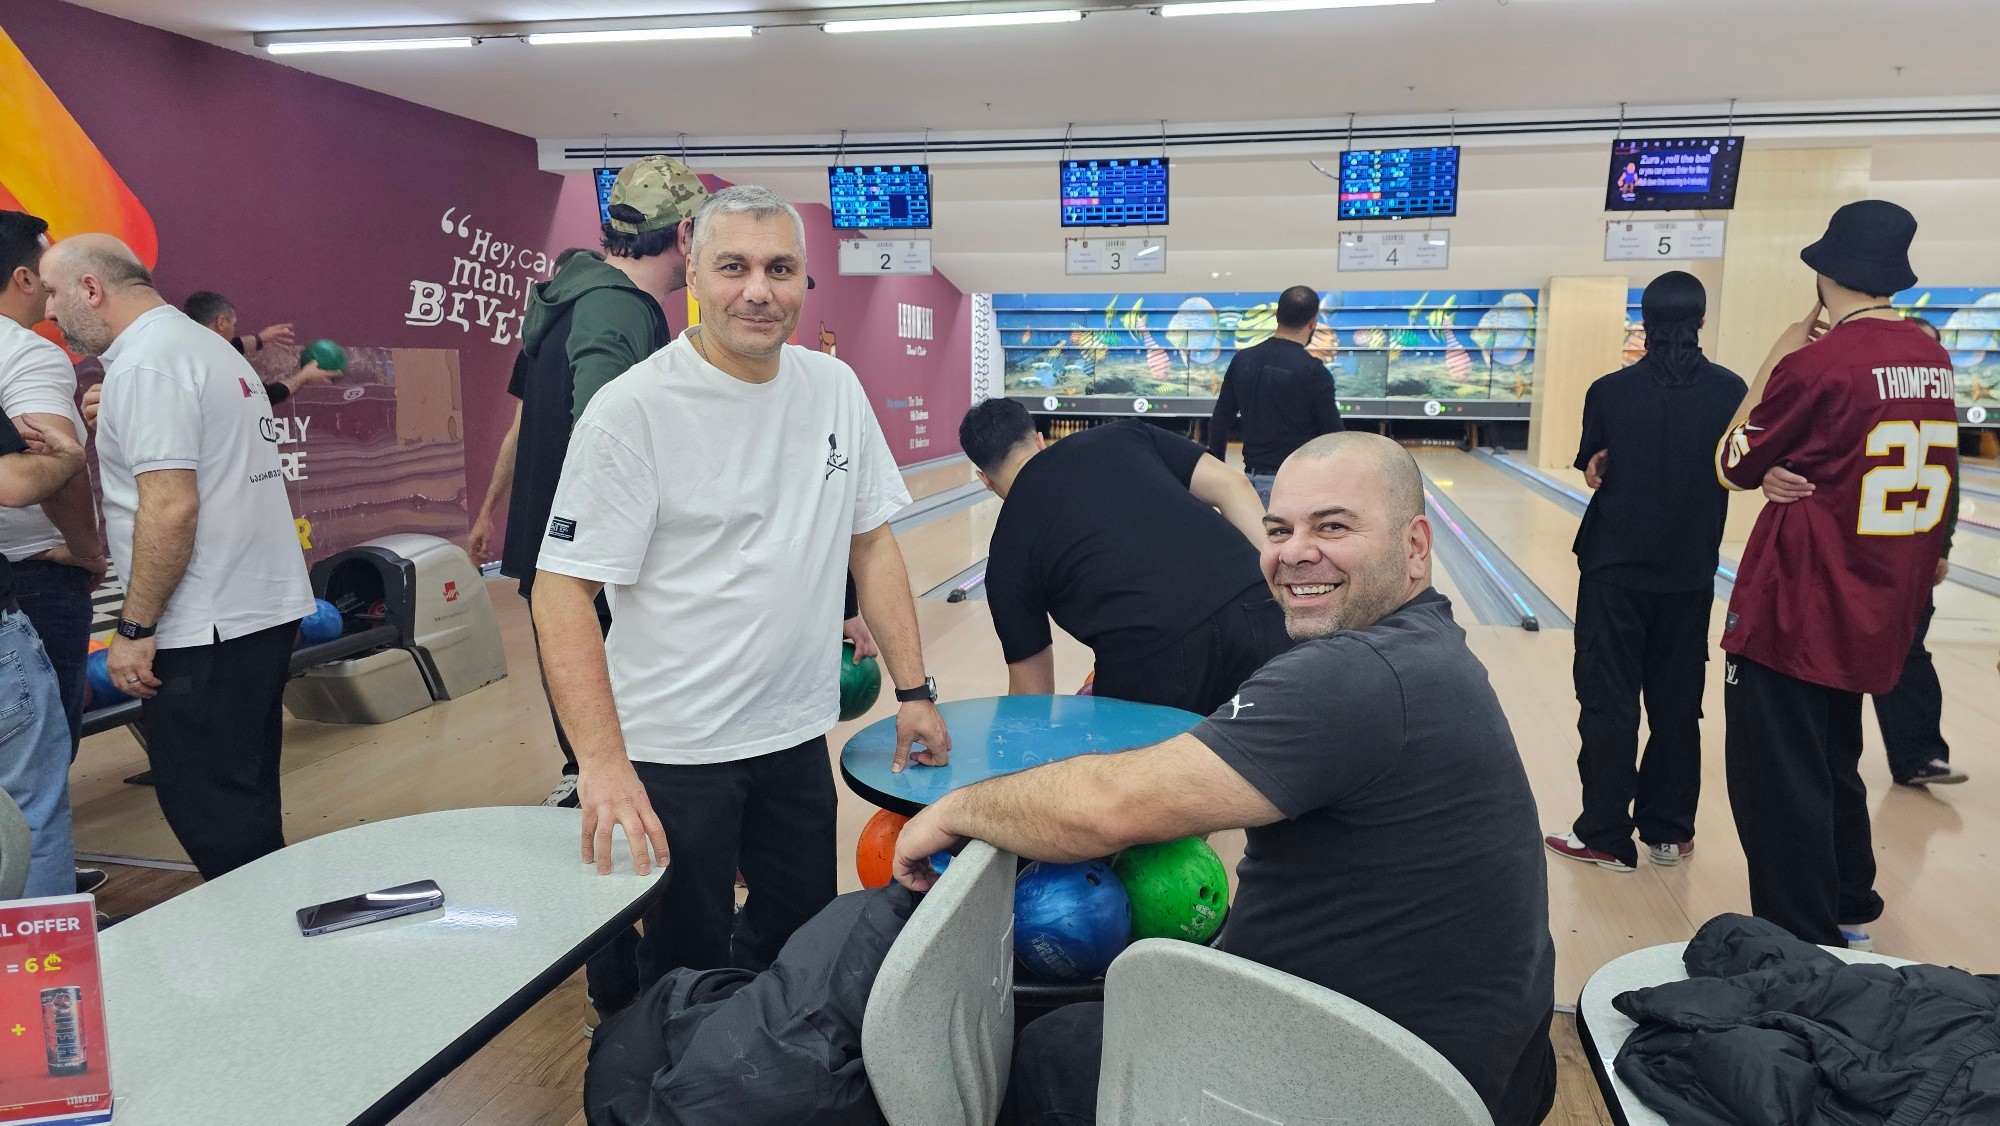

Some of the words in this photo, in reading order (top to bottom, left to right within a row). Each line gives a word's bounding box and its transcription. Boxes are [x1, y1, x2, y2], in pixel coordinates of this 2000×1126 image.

[1657, 236, 1671, 255] 5
[880, 253, 891, 270] 2
[1111, 252, 1121, 270] 3
[1386, 247, 1399, 266] 4
[448, 256, 521, 300] man,
[1429, 403, 1437, 413] 5
[1857, 420, 1958, 535] 25
[17, 917, 80, 936] OFFER
[24, 957, 39, 973] 6
